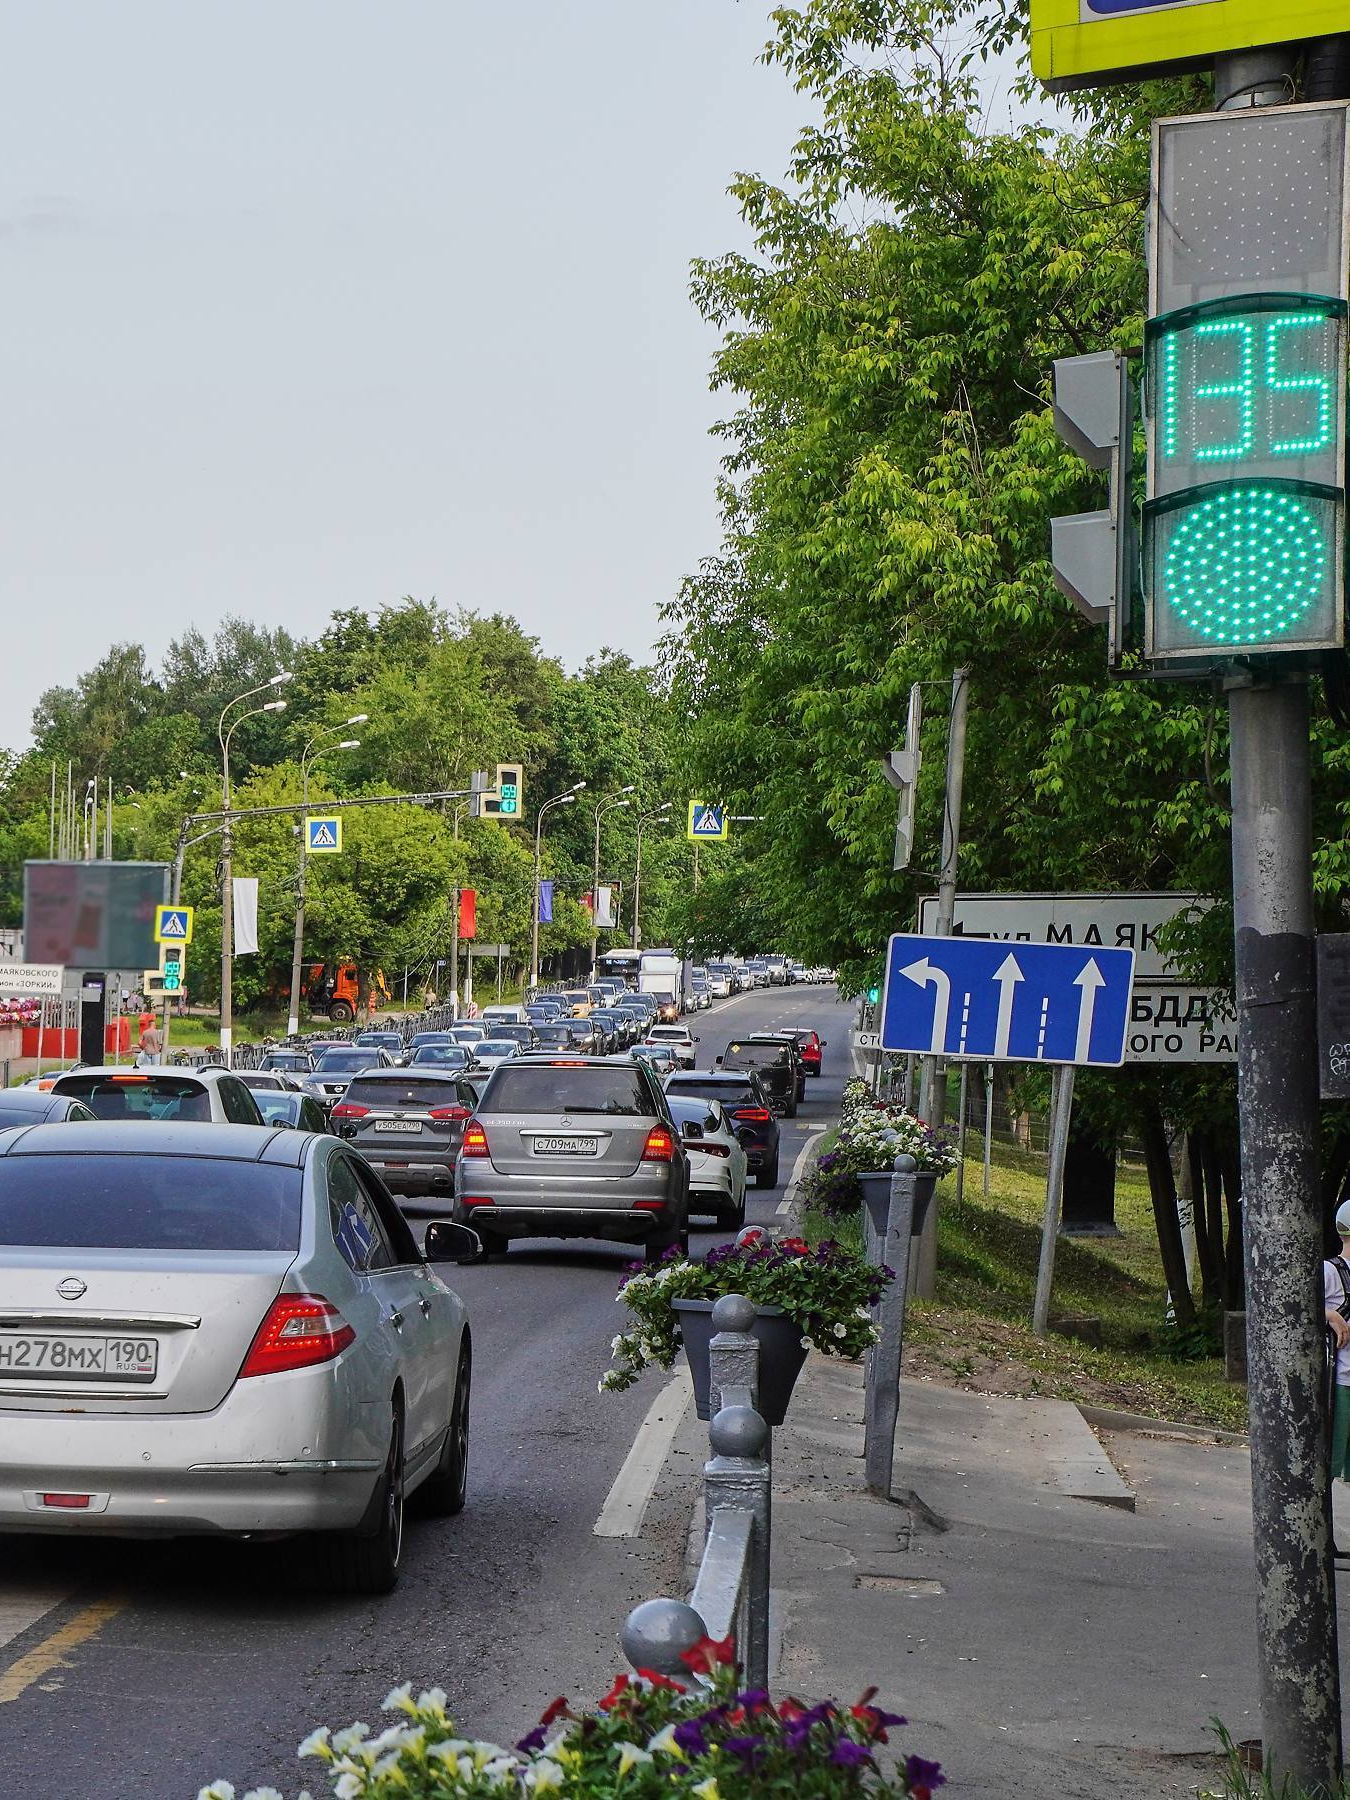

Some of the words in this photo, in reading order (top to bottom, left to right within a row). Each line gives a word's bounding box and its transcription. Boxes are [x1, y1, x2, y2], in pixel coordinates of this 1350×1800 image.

[1164, 314, 1329, 458] 135
[859, 1034, 880, 1046] СТ
[1125, 1034, 1183, 1053] ОГО
[537, 1139, 577, 1150] С709МА
[579, 1139, 595, 1147] 799
[109, 1341, 149, 1362] 190
[116, 1362, 137, 1371] RUS
